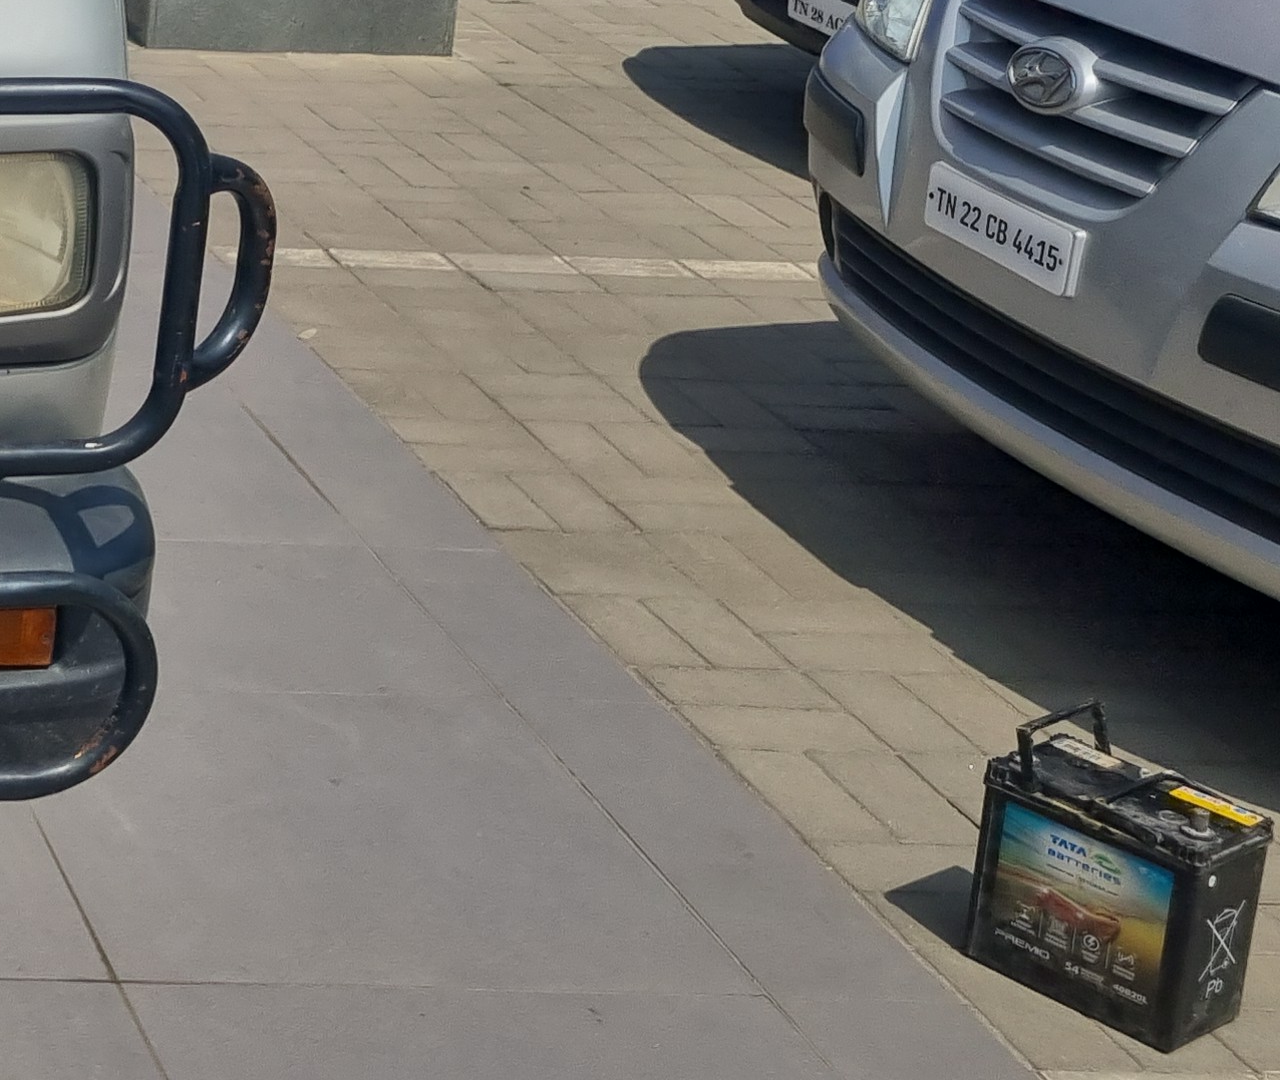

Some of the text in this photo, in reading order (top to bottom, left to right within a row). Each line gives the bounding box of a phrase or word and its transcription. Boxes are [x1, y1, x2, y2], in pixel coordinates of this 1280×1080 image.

[810, 6, 824, 24] 28
[937, 187, 1060, 272] TN 22 CB 4415
[1049, 833, 1088, 858] TATA
[1205, 977, 1224, 999] Pb
